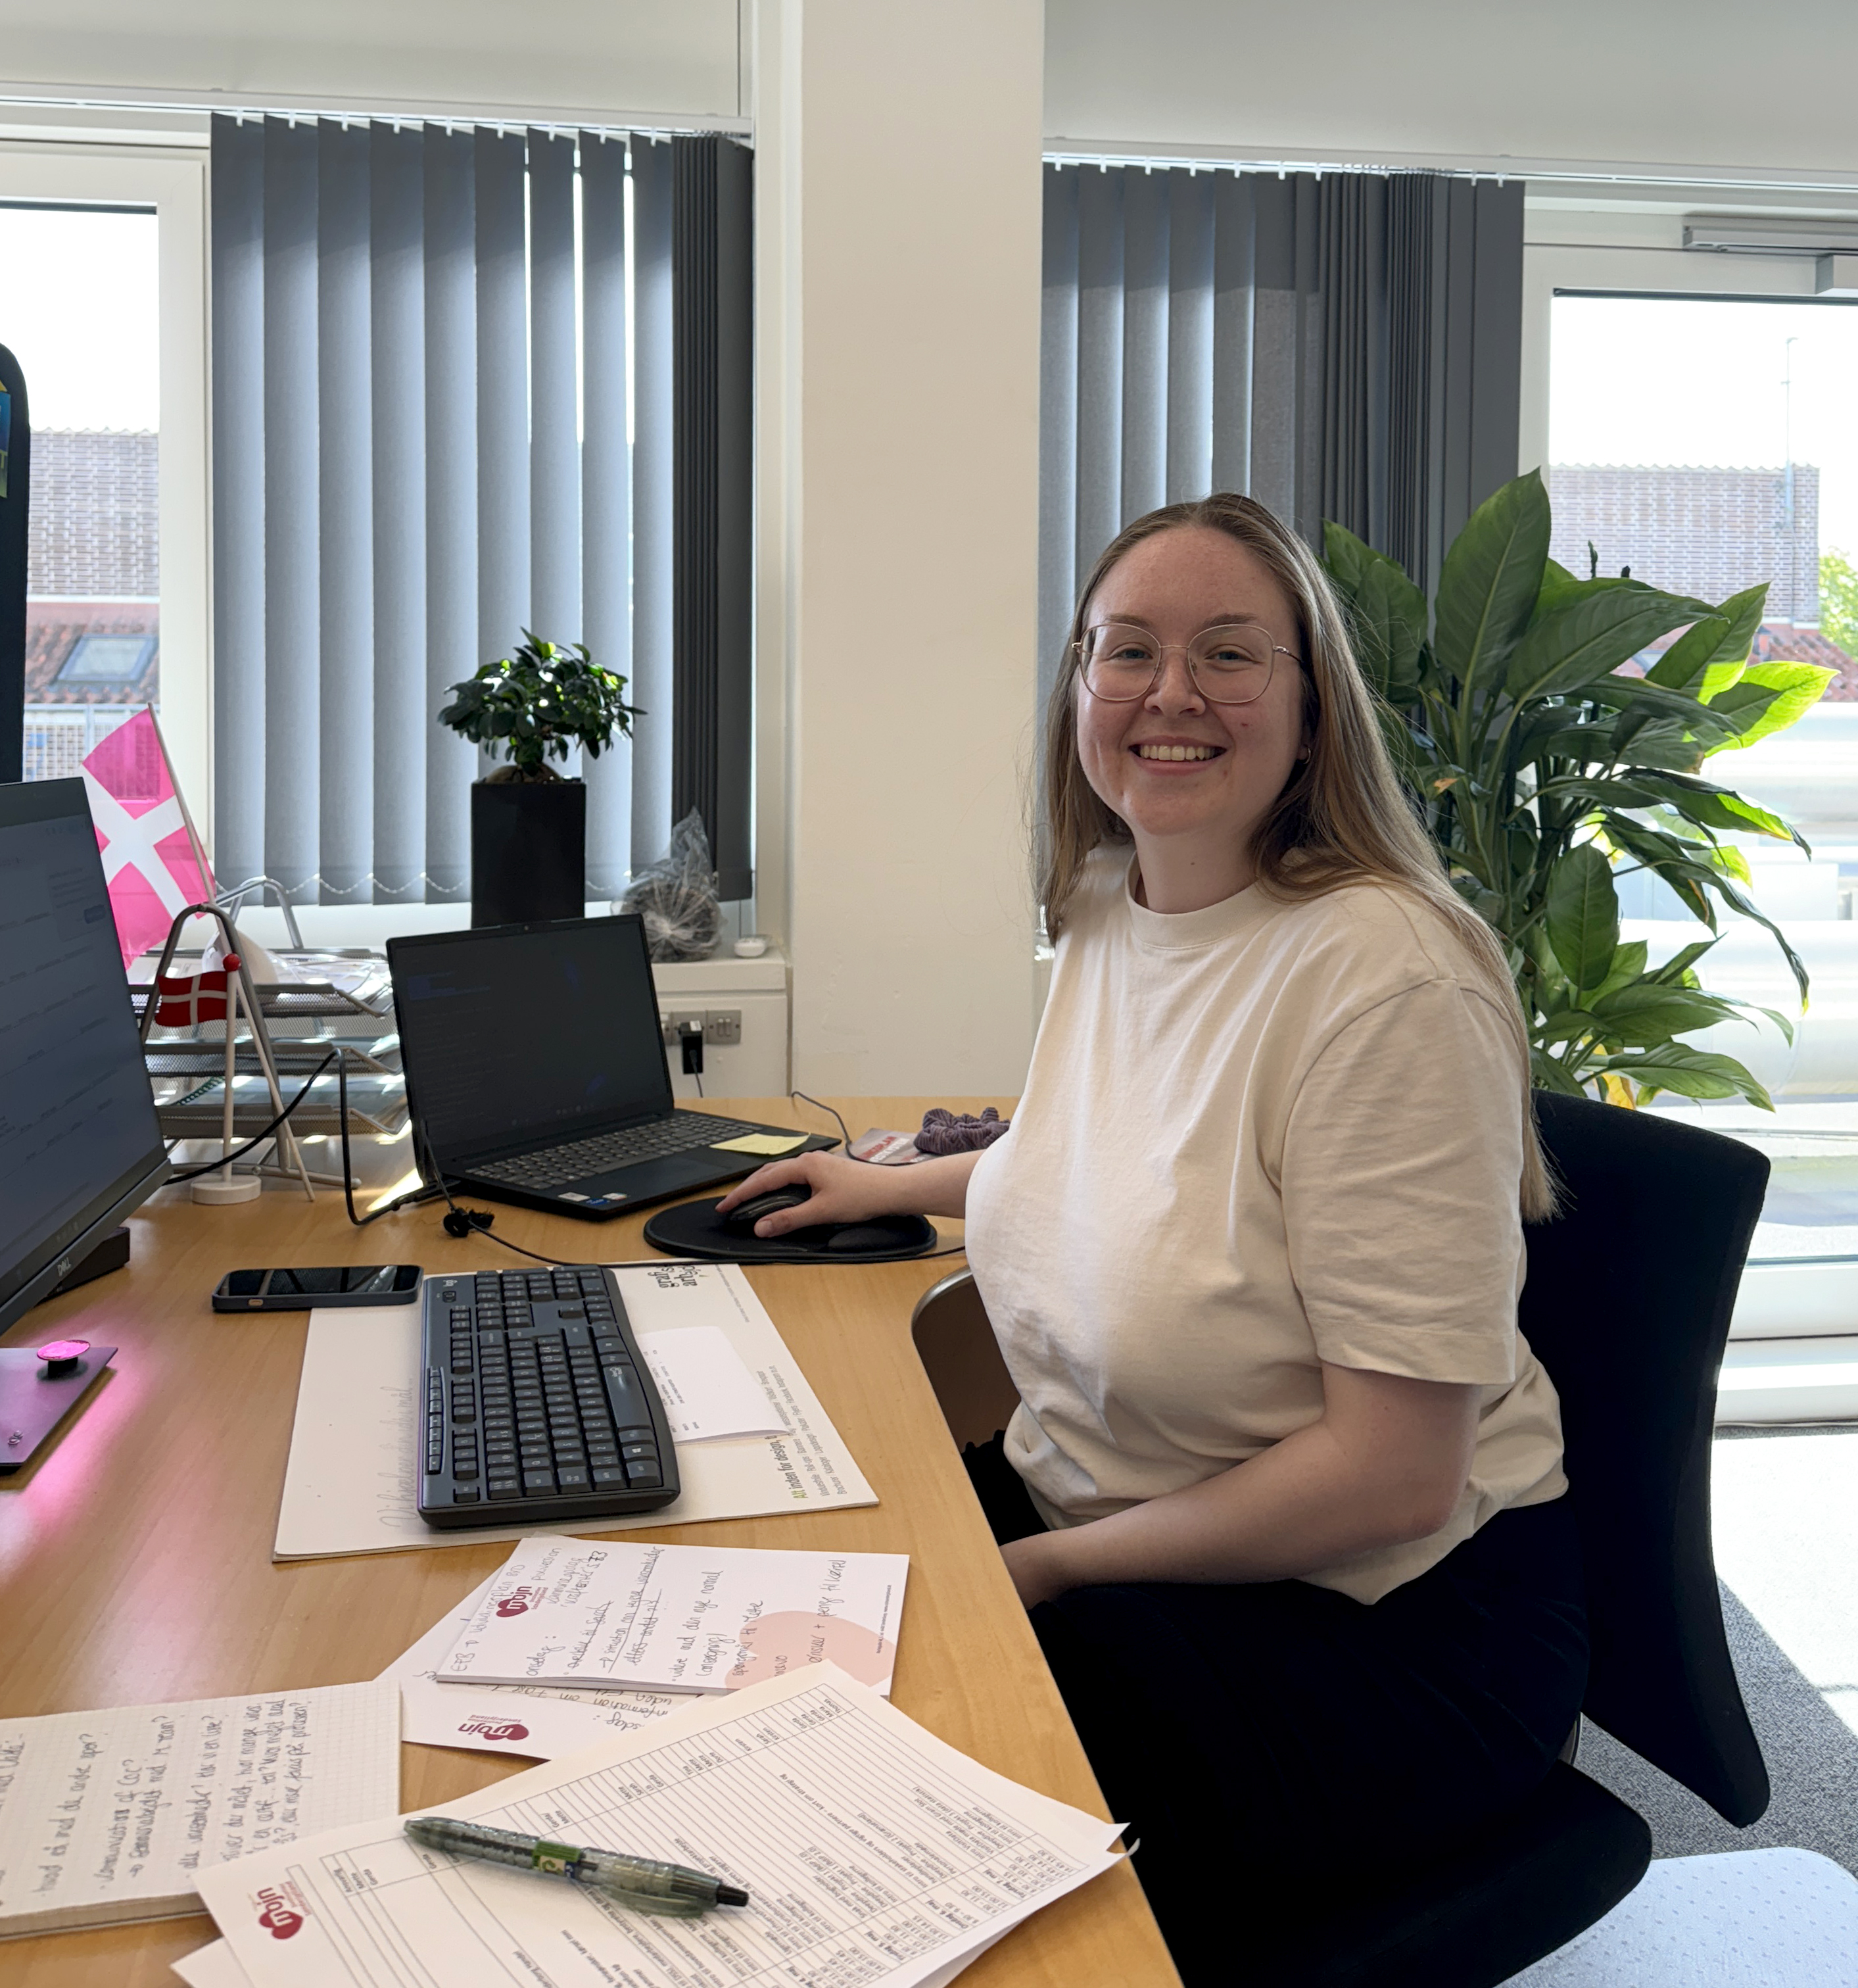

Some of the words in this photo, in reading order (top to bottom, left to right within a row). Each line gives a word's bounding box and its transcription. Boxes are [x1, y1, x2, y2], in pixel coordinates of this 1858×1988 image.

[778, 1463, 794, 1471] for
[785, 1472, 803, 1490] inden
[791, 1490, 808, 1498] Alt
[700, 1570, 723, 1594] normal
[501, 1585, 536, 1609] mojn
[693, 1599, 718, 1613] nye
[806, 1635, 824, 1663] ønsker
[592, 1698, 671, 1718] nformation
[819, 1707, 834, 1718] Maria
[824, 1699, 842, 1713] Thomas
[801, 1714, 816, 1725] Gerda
[810, 1710, 825, 1721] Gerda
[792, 1718, 807, 1729] Gerda
[456, 1720, 513, 1741] mojn
[763, 1728, 780, 1740] Kirsten
[735, 1739, 752, 1751] Kirsten
[756, 1733, 771, 1744] Sarah
[698, 1755, 713, 1767] Mette
[709, 1753, 724, 1763] Dorte
[682, 1766, 694, 1775] Tina
[689, 1759, 704, 1771] Mette
[649, 1774, 664, 1787] Gerda
[618, 1787, 633, 1799] Mette
[629, 1783, 644, 1795] Sarah
[785, 1780, 805, 1795] strategi
[913, 1785, 936, 1803] statistik)
[812, 1801, 824, 1810] kort
[915, 1798, 927, 1807] Slot
[936, 1803, 952, 1813] (data
[556, 1811, 569, 1824] Mette
[926, 1806, 941, 1817] Gram
[972, 1807, 1001, 1826] kollegerne
[542, 1813, 560, 1828] Gerda/
[827, 1812, 851, 1830] partnere
[857, 1811, 894, 1838] (Grænseland)
[939, 1816, 954, 1826] med
[953, 1815, 974, 1830] Projekt
[964, 1811, 992, 1830] kollegerne
[849, 1829, 867, 1842] vigtige
[953, 1826, 970, 1837] møde
[1007, 1829, 1022, 1839] Intro
[946, 1831, 970, 1850] VisitData
[977, 1831, 1004, 1849] Deepdive
[998, 1833, 1013, 1844] Intro
[896, 1841, 917, 1856] Projekt
[969, 1837, 994, 1854] VisitData
[675, 1838, 711, 1868] projektarbejde
[873, 1847, 907, 1872] stakeholders
[915, 1843, 957, 1874] Personalemøde
[970, 1849, 985, 1859] Intro
[423, 1853, 437, 1869] Gerda
[709, 1856, 730, 1872] opgaver
[920, 1859, 947, 1879] Deepdive
[984, 1868, 997, 1879] maj
[334, 1868, 352, 1893] Ansvarlig
[352, 1873, 364, 1889] Mette
[364, 1869, 378, 1885] Gerda
[728, 1872, 744, 1884] deres
[828, 1874, 848, 1891] Projekt
[837, 1869, 857, 1885] Projekt
[849, 1866, 877, 1887] kollegerne
[913, 1876, 928, 1888] Intro
[813, 1876, 841, 1897] bogholder
[839, 1897, 853, 1906] med
[851, 1893, 878, 1913] Deepdive
[861, 1887, 888, 1908] Deepdive
[883, 1891, 897, 1903] Intro
[257, 1887, 295, 1927] mojn
[776, 1899, 805, 1922] kollegerne
[787, 1894, 815, 1917] kollegerne
[926, 1900, 940, 1910] maj
[852, 1906, 867, 1918] Snak
[809, 1926, 824, 1939] Intro
[820, 1922, 835, 1933] Intro
[798, 1931, 814, 1944] Intro
[865, 1931, 878, 1941] maj
[700, 1934, 727, 1958] kollegerne
[732, 1964, 747, 1977] Intro
[786, 1966, 799, 1977] maj
